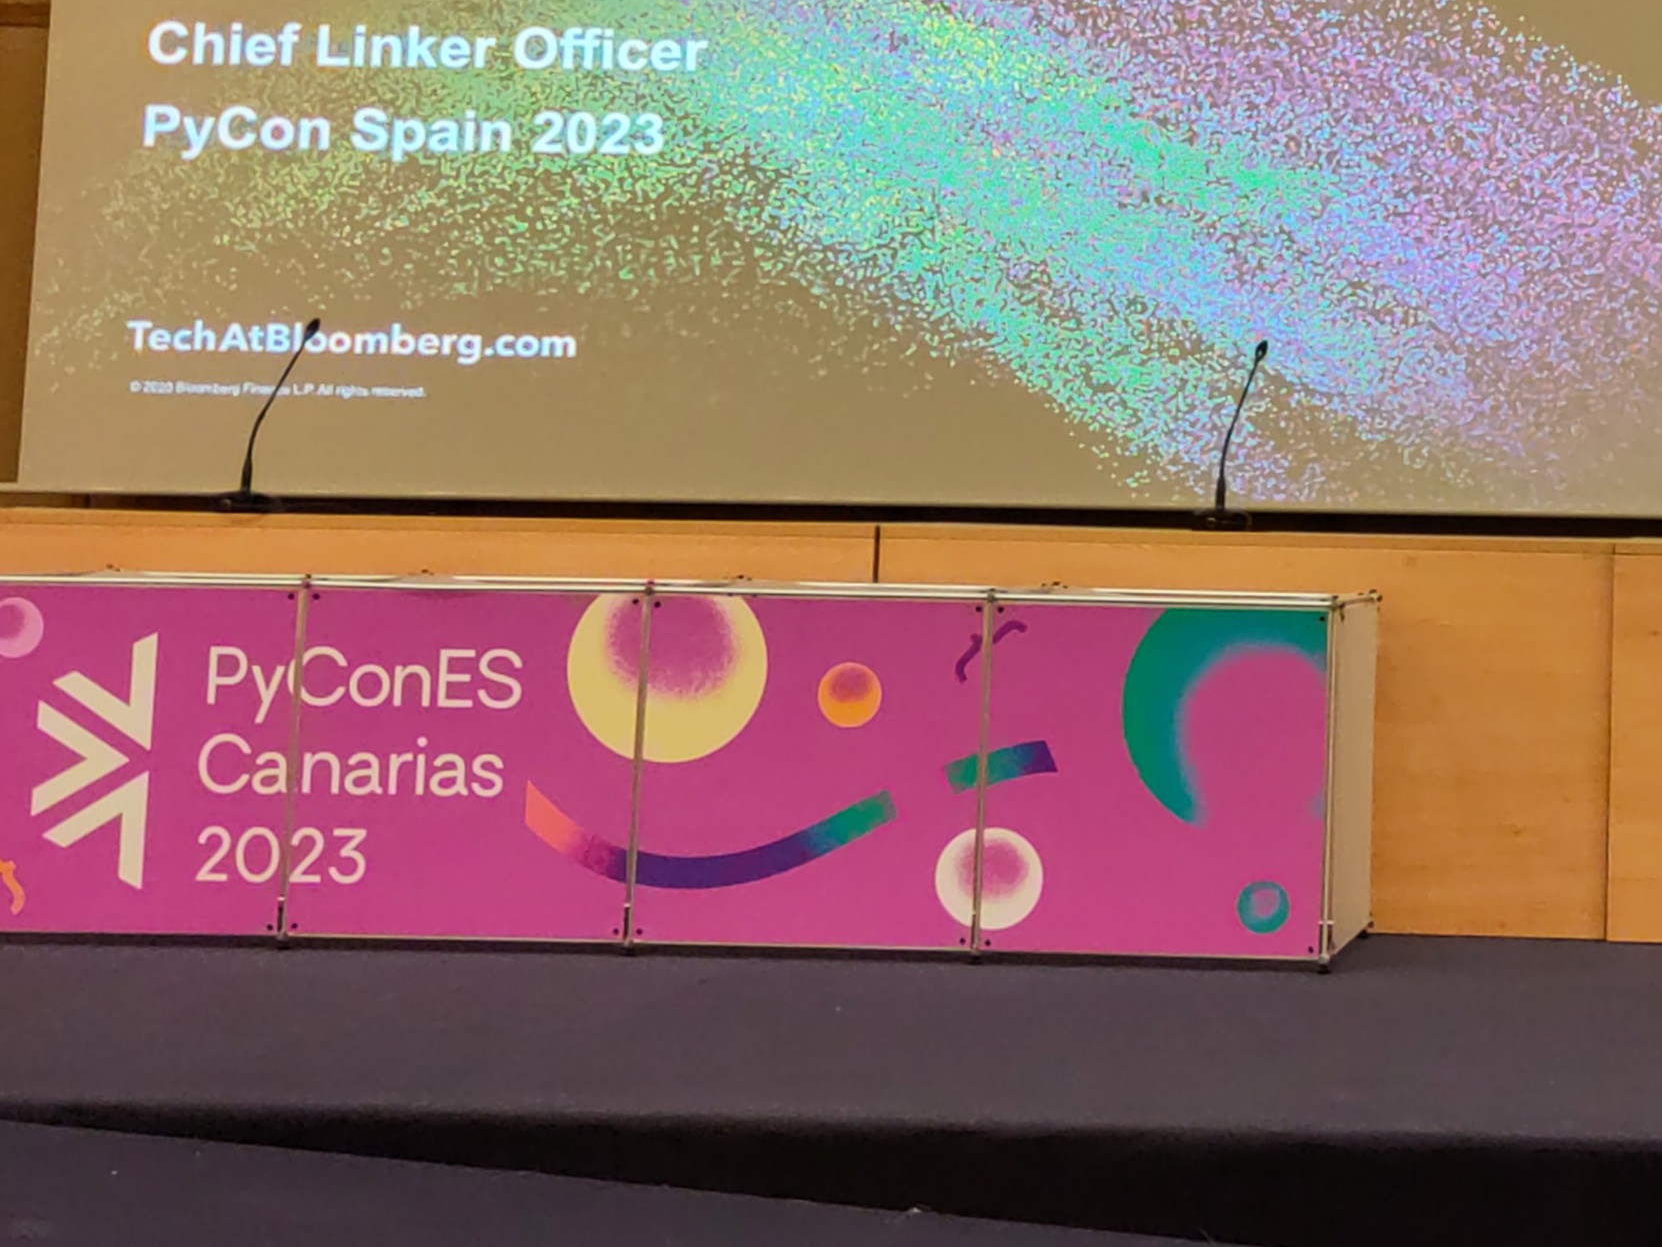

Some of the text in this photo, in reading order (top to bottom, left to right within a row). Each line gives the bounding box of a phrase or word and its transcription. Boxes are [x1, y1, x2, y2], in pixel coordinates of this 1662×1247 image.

[147, 20, 709, 73] Chief Linker Officer
[142, 104, 666, 162] PyCon Spain 2023
[126, 319, 577, 366] TechAtBloomberg.com
[204, 644, 524, 725] PyConES
[196, 732, 505, 798] Canarias
[194, 824, 368, 885] 2023
